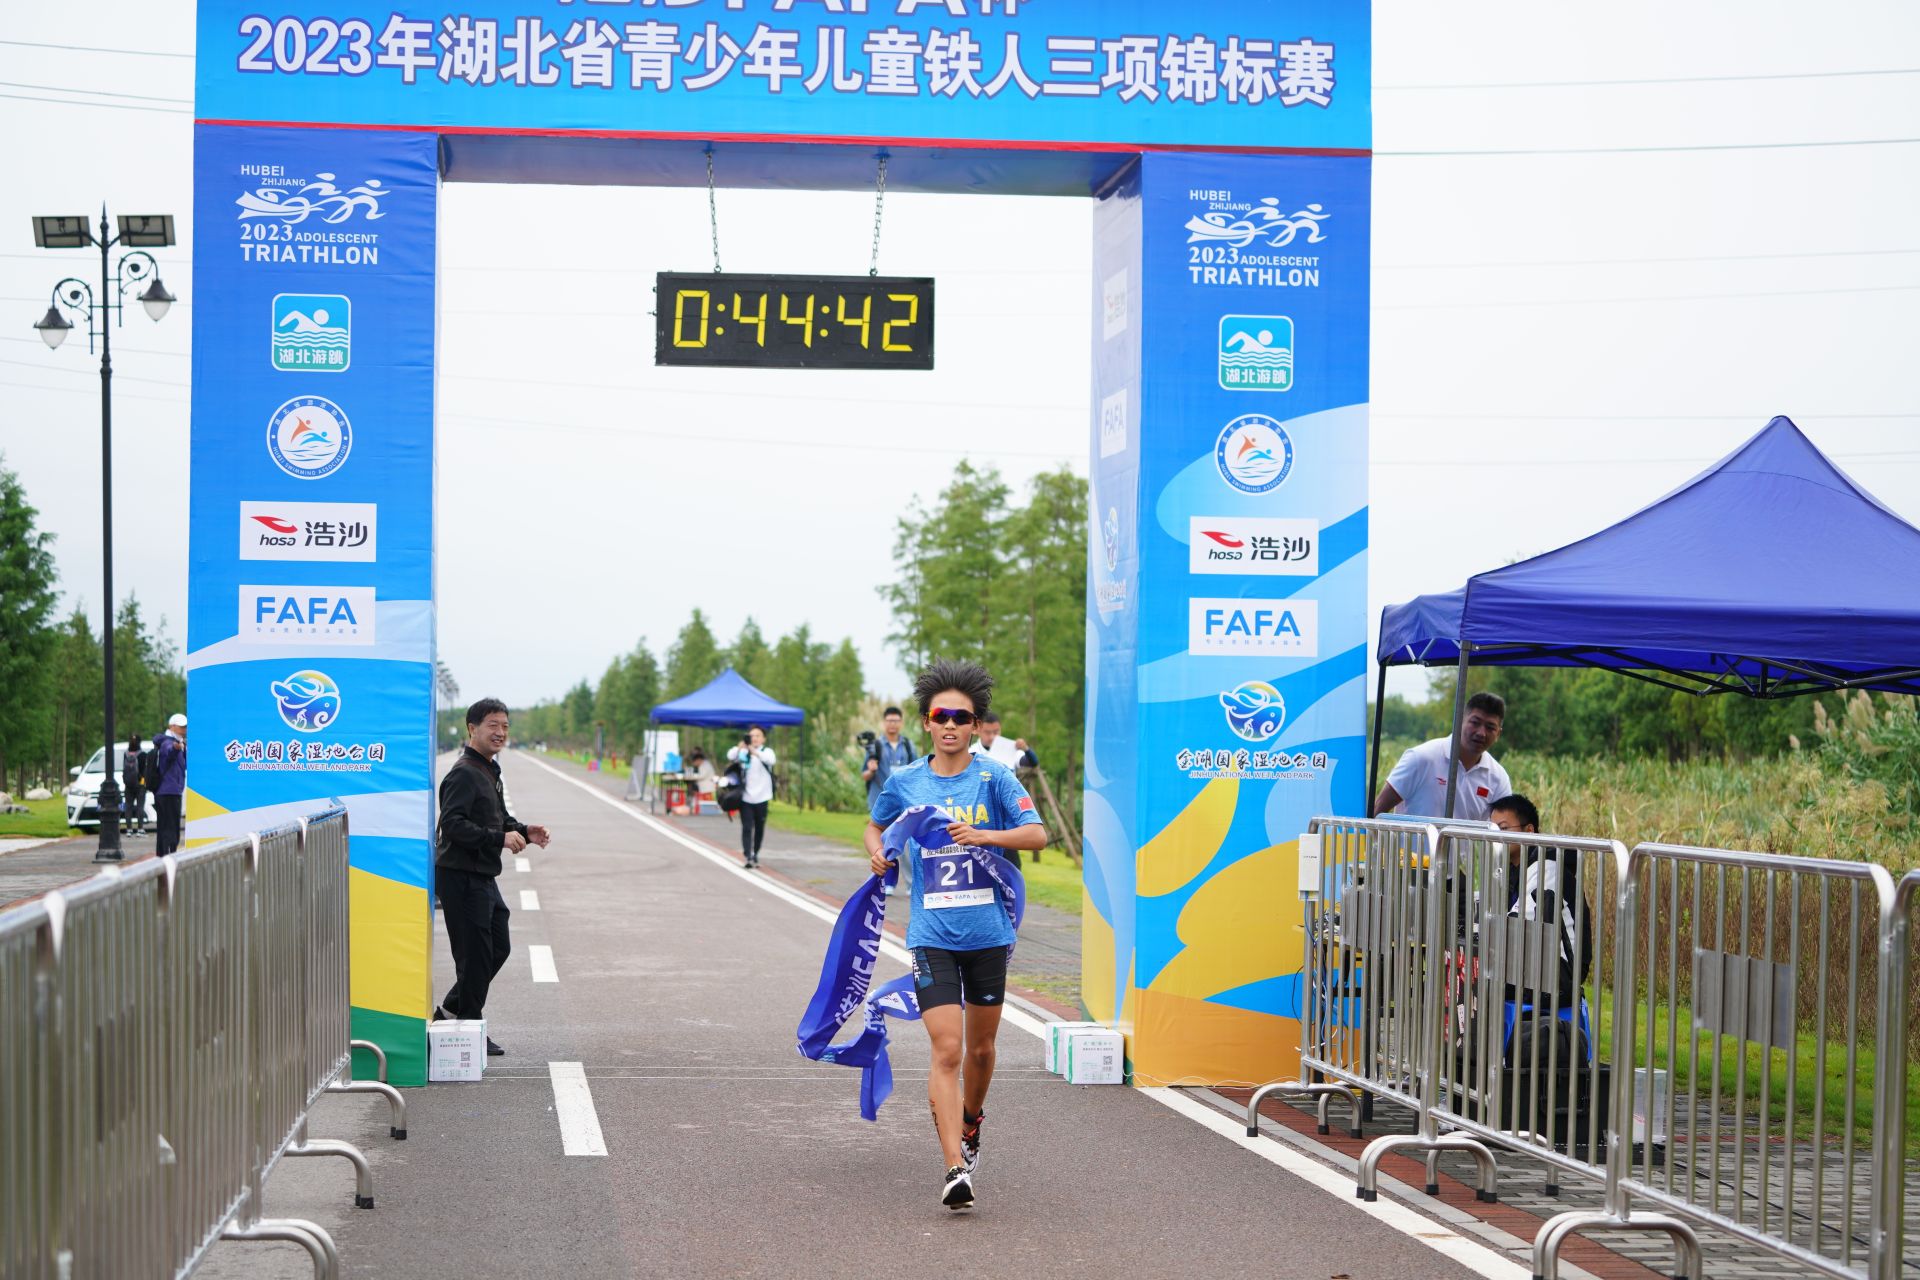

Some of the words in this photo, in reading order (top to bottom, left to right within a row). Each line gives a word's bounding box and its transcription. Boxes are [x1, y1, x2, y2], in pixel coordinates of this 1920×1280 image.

[237, 13, 1335, 108] 2023年湖北省青少年儿童铁人三项锦标赛
[240, 165, 285, 176] HUBEI
[261, 178, 306, 187] ZHIJIANG
[1190, 190, 1231, 201] HUBEI
[1209, 202, 1251, 211] ZHIJIANG
[240, 223, 293, 242] 2023
[295, 232, 378, 244] ADOLESCENT
[240, 244, 378, 265] TRIATHLON
[1189, 247, 1239, 264] 2023
[1240, 255, 1319, 267] ADOLESCENT
[1189, 267, 1319, 287] TRIATHLON
[673, 289, 919, 352] 0:44:42
[273, 446, 285, 465] HUBEI
[285, 463, 316, 476] SWIMMING
[318, 445, 348, 475] ASSOCIATION
[259, 533, 297, 546] hosa
[304, 521, 368, 547] 浩沙
[1208, 548, 1243, 561] hosa
[1251, 536, 1311, 561] 浩沙
[256, 596, 358, 625] FAFA
[1205, 609, 1301, 637] FAFA
[225, 740, 385, 763] 金湖国家湿地公园
[1177, 749, 1327, 769] 金湖国家湿地公园
[264, 762, 306, 771] NATIONAL
[308, 762, 347, 771] WETLAND
[349, 763, 371, 771] PARK
[944, 797, 990, 825] INA
[940, 859, 975, 886] 21
